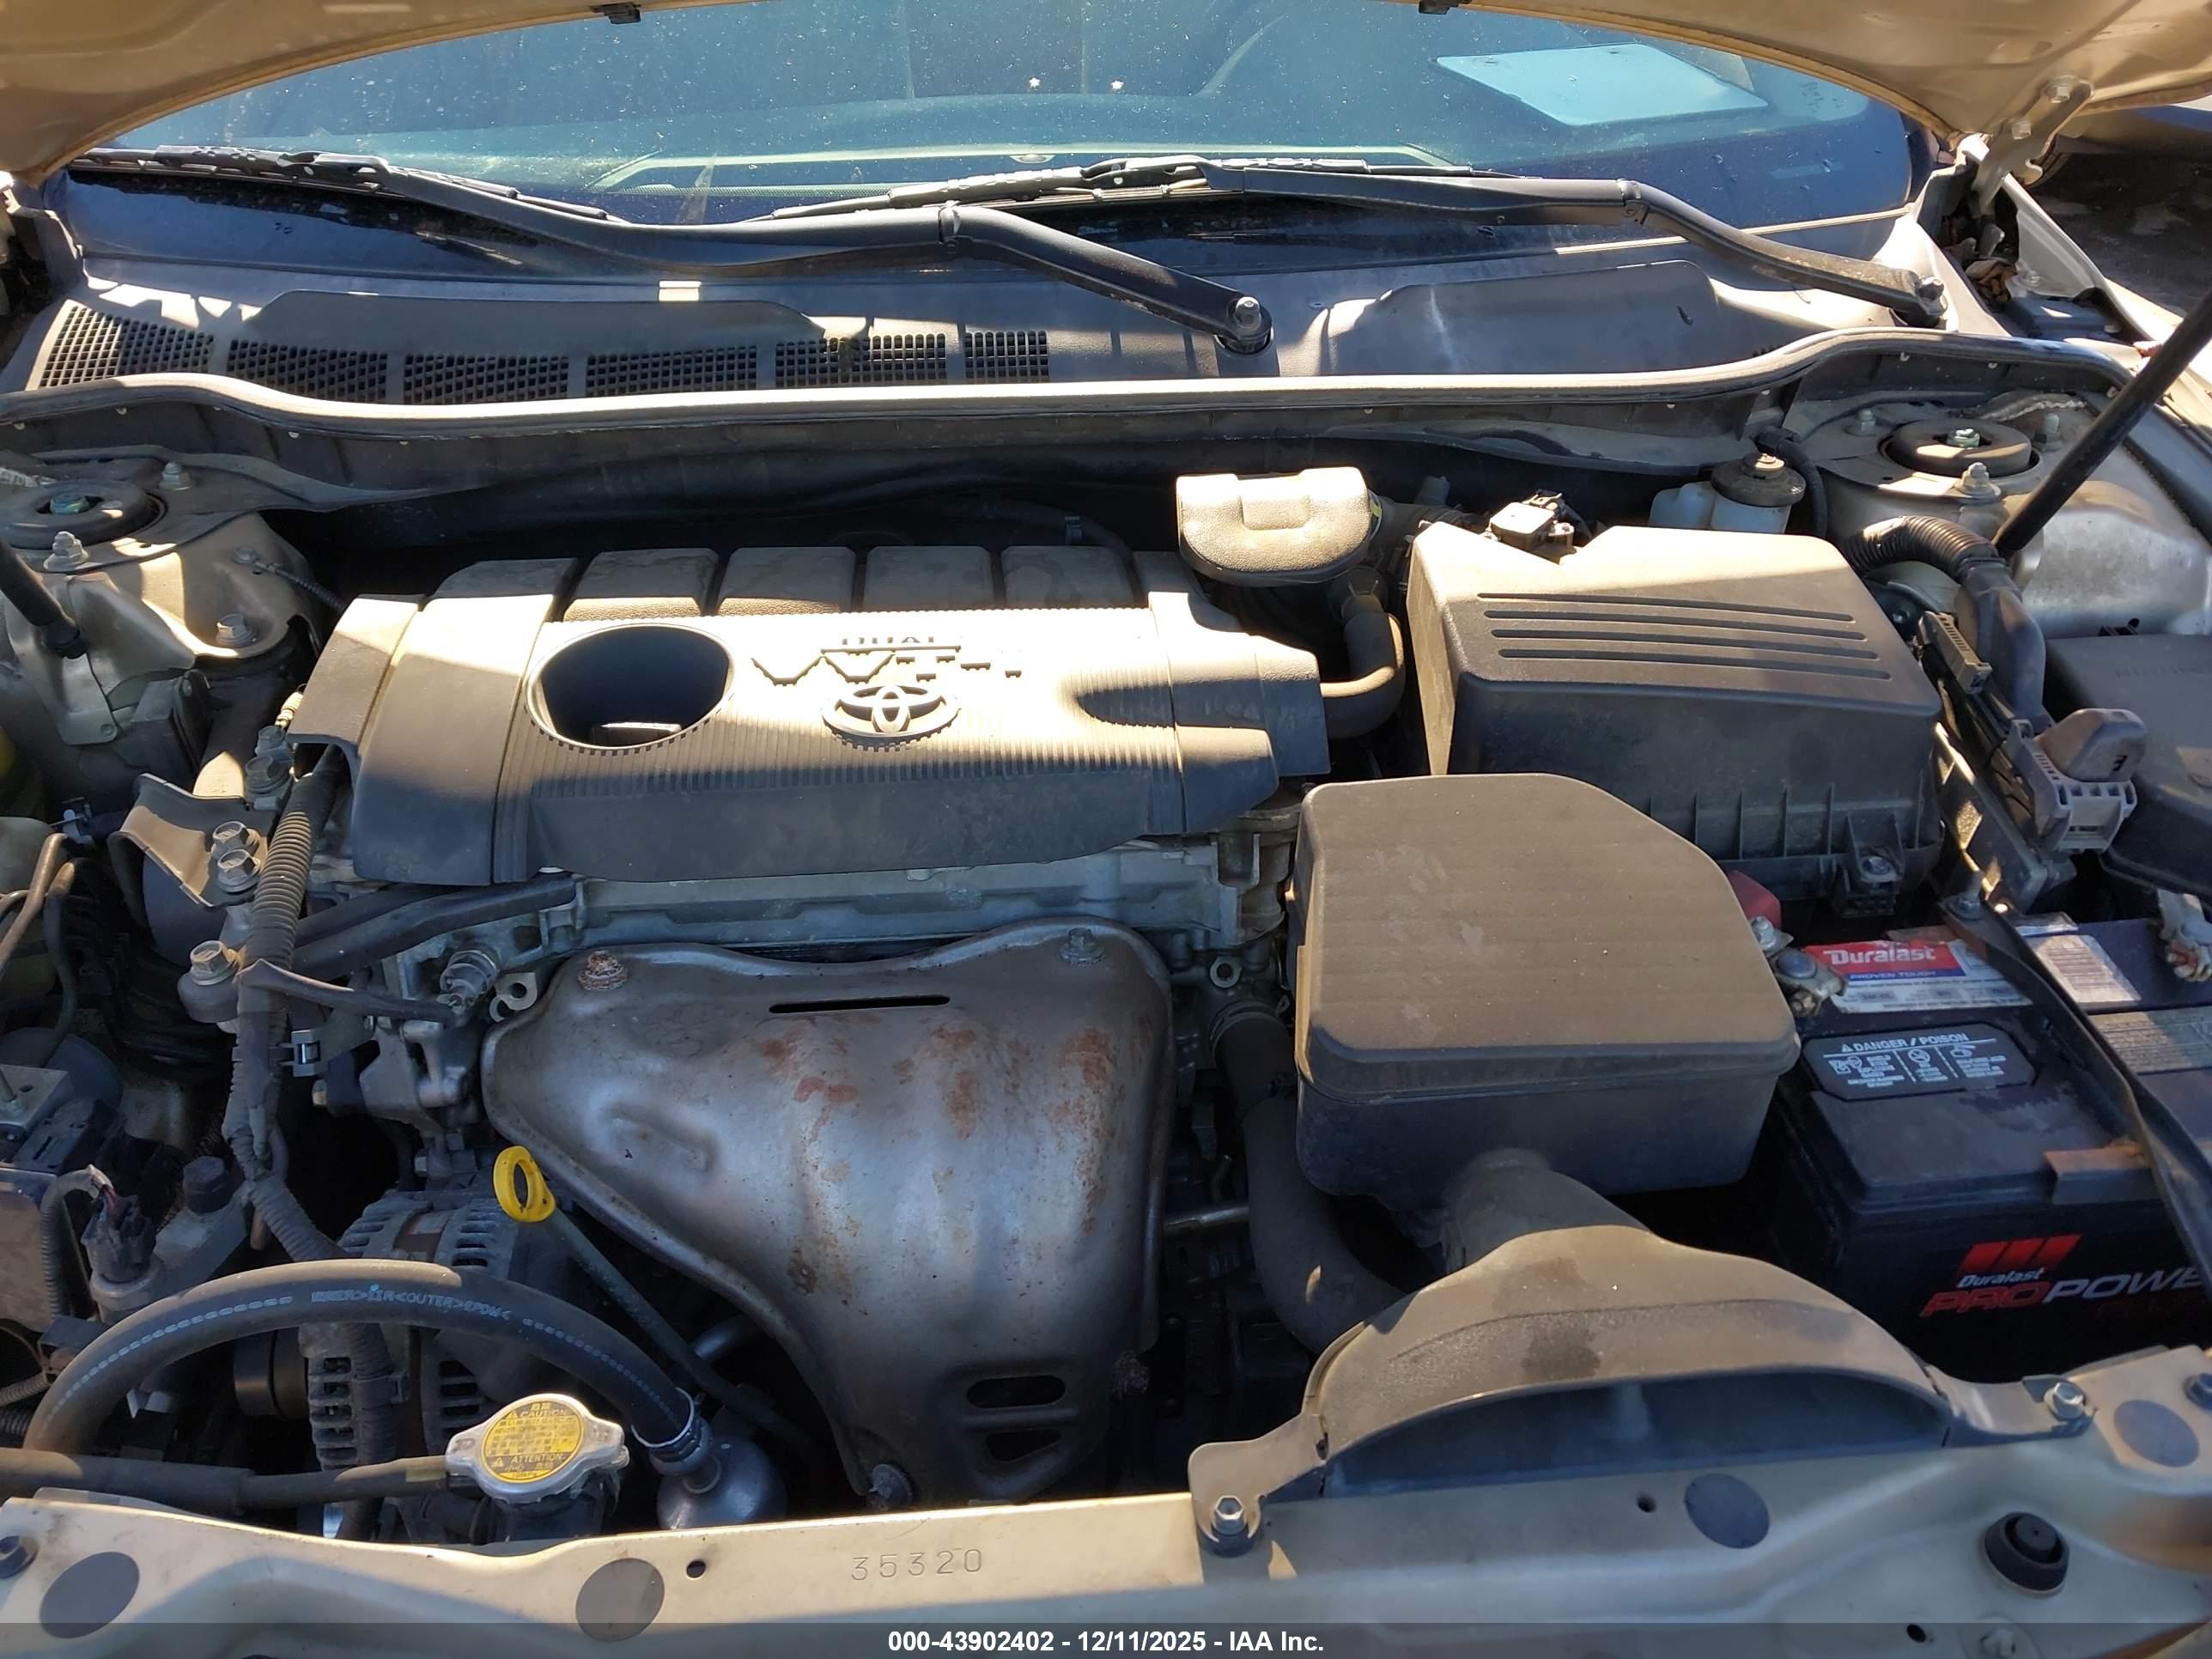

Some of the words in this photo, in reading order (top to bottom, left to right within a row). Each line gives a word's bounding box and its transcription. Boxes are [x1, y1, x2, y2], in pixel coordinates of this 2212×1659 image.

[1822, 945, 1936, 966] Duralast
[1849, 971, 1896, 981] PROVEN
[1852, 1037, 1909, 1053] DANGER
[1919, 1032, 1970, 1045] POISON
[1956, 1267, 2046, 1288] Duralast
[520, 1408, 565, 1418] CAUTION
[851, 1548, 982, 1581] 35320
